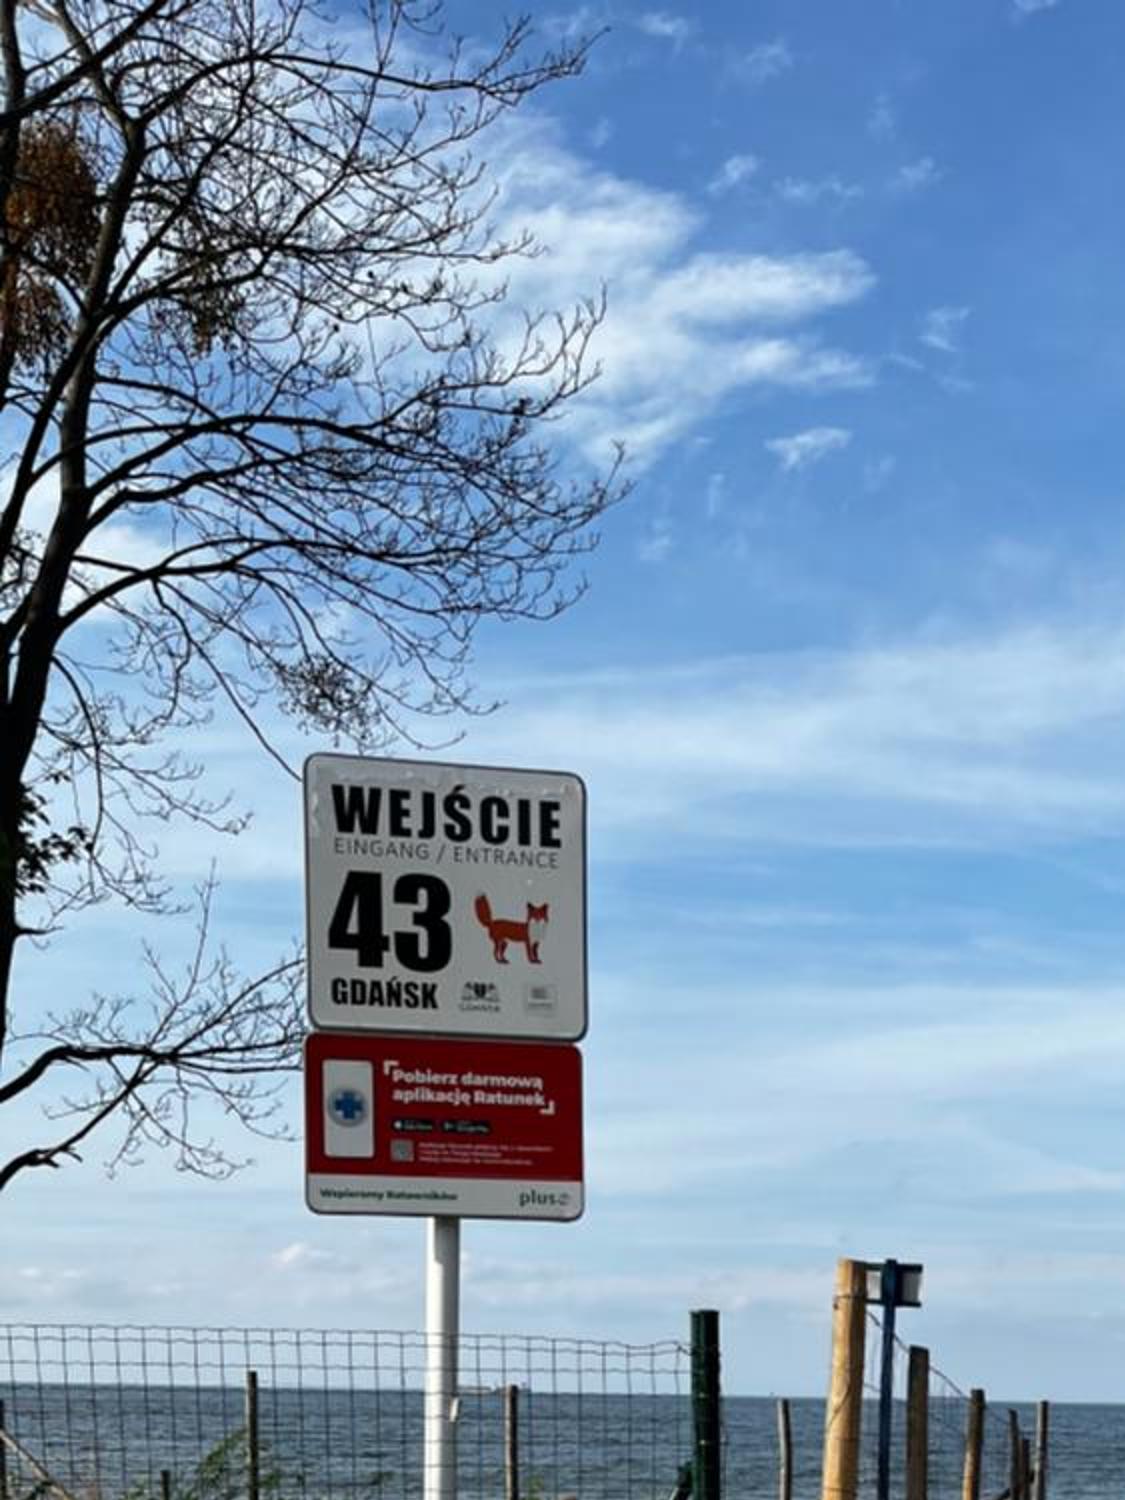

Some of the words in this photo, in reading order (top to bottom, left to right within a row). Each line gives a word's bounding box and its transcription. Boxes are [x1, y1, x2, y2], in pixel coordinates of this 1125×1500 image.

[331, 784, 561, 849] WEJŚCIE
[334, 837, 430, 861] EINGANG
[454, 846, 560, 869] ENTRANCE
[328, 869, 452, 973] 43
[331, 976, 439, 1010] GDAŃSK
[392, 1068, 458, 1084] Pobierz
[461, 1072, 543, 1090] darmową
[393, 1087, 471, 1106] aplikację
[474, 1090, 545, 1106] Ratunek
[519, 1188, 556, 1207] plus
